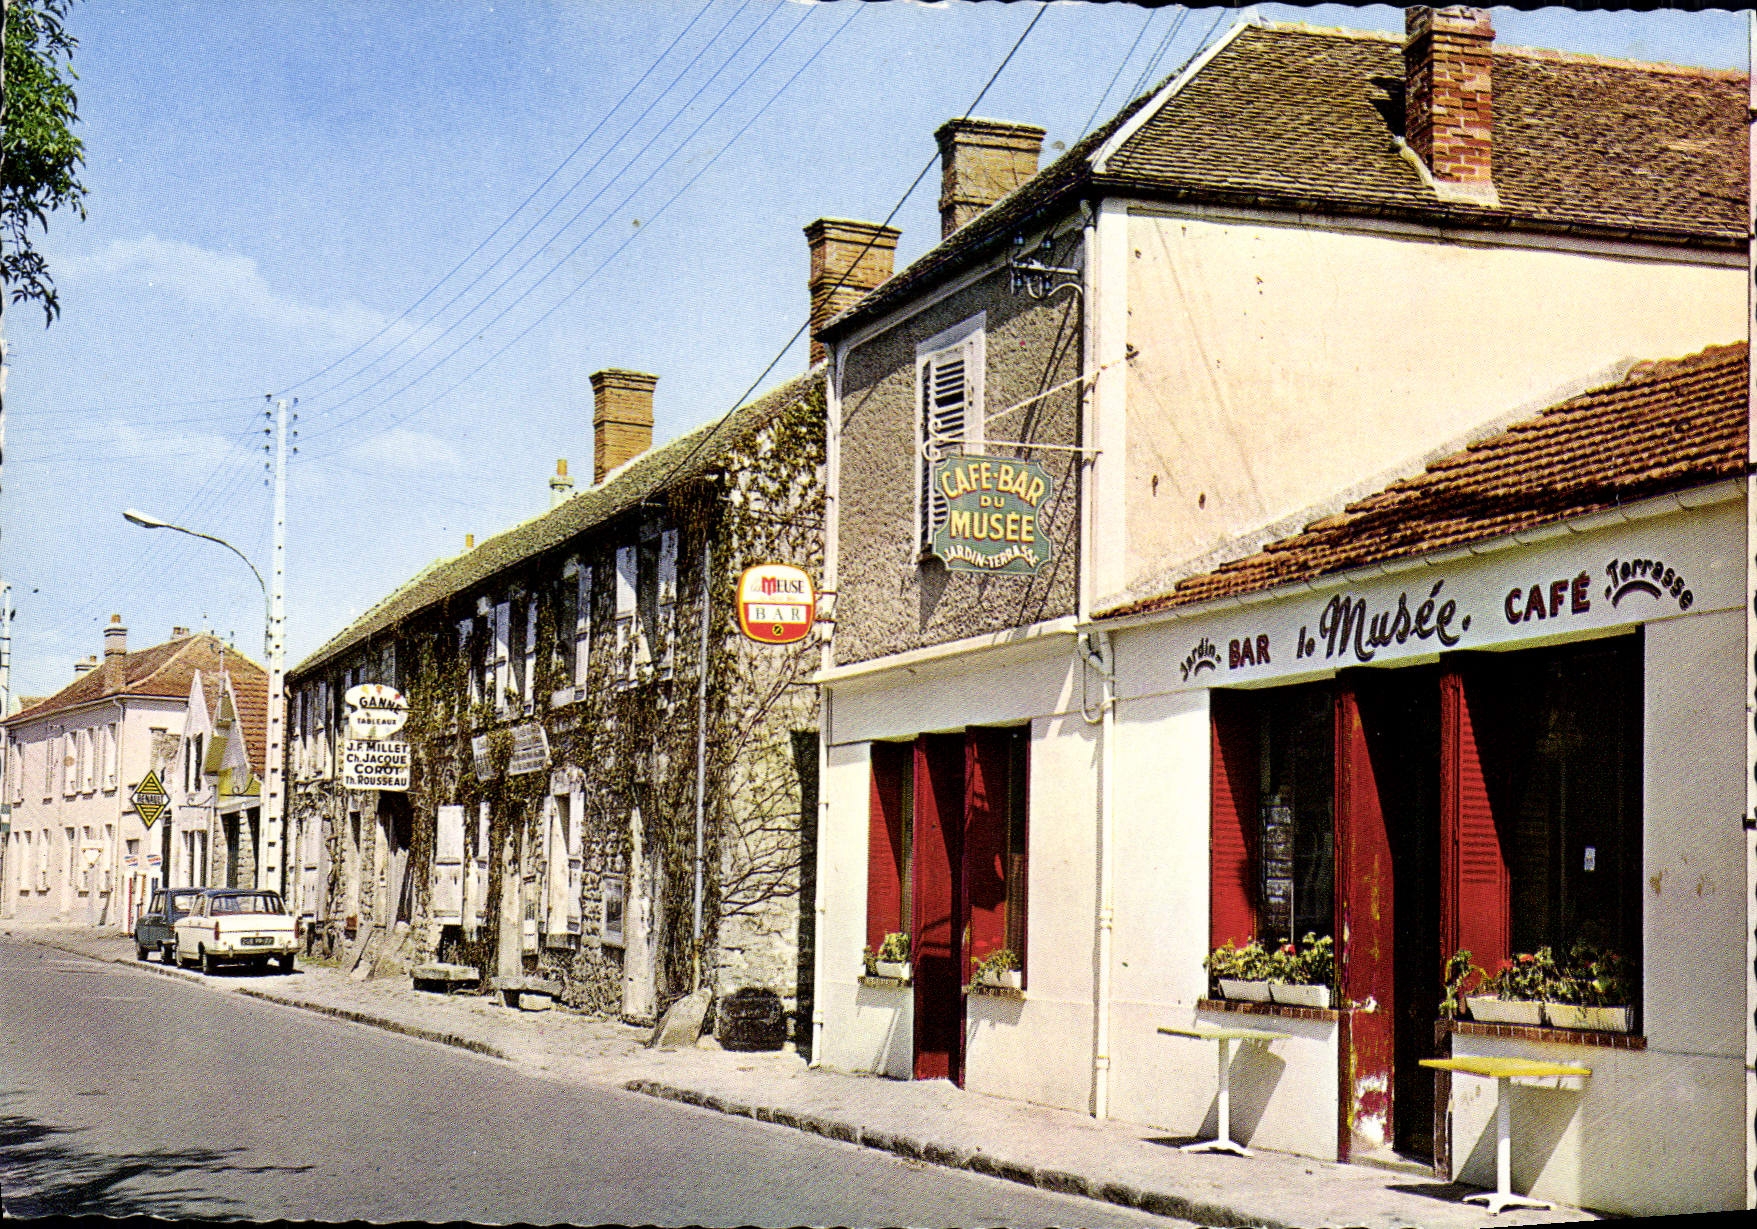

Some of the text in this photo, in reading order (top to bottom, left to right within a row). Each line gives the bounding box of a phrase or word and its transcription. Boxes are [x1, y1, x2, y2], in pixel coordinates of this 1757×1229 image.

[980, 495, 1005, 508] DU
[761, 576, 804, 596] MEUSE
[1504, 570, 1591, 624] CAFÉ
[755, 607, 801, 620] BAR
[1228, 634, 1271, 670] BAR
[357, 717, 397, 725] TABLEAUX
[366, 741, 408, 753] MILLET
[362, 753, 407, 764] JACQUE
[354, 763, 400, 775] COROT
[357, 774, 407, 786] ROUSSEAU
